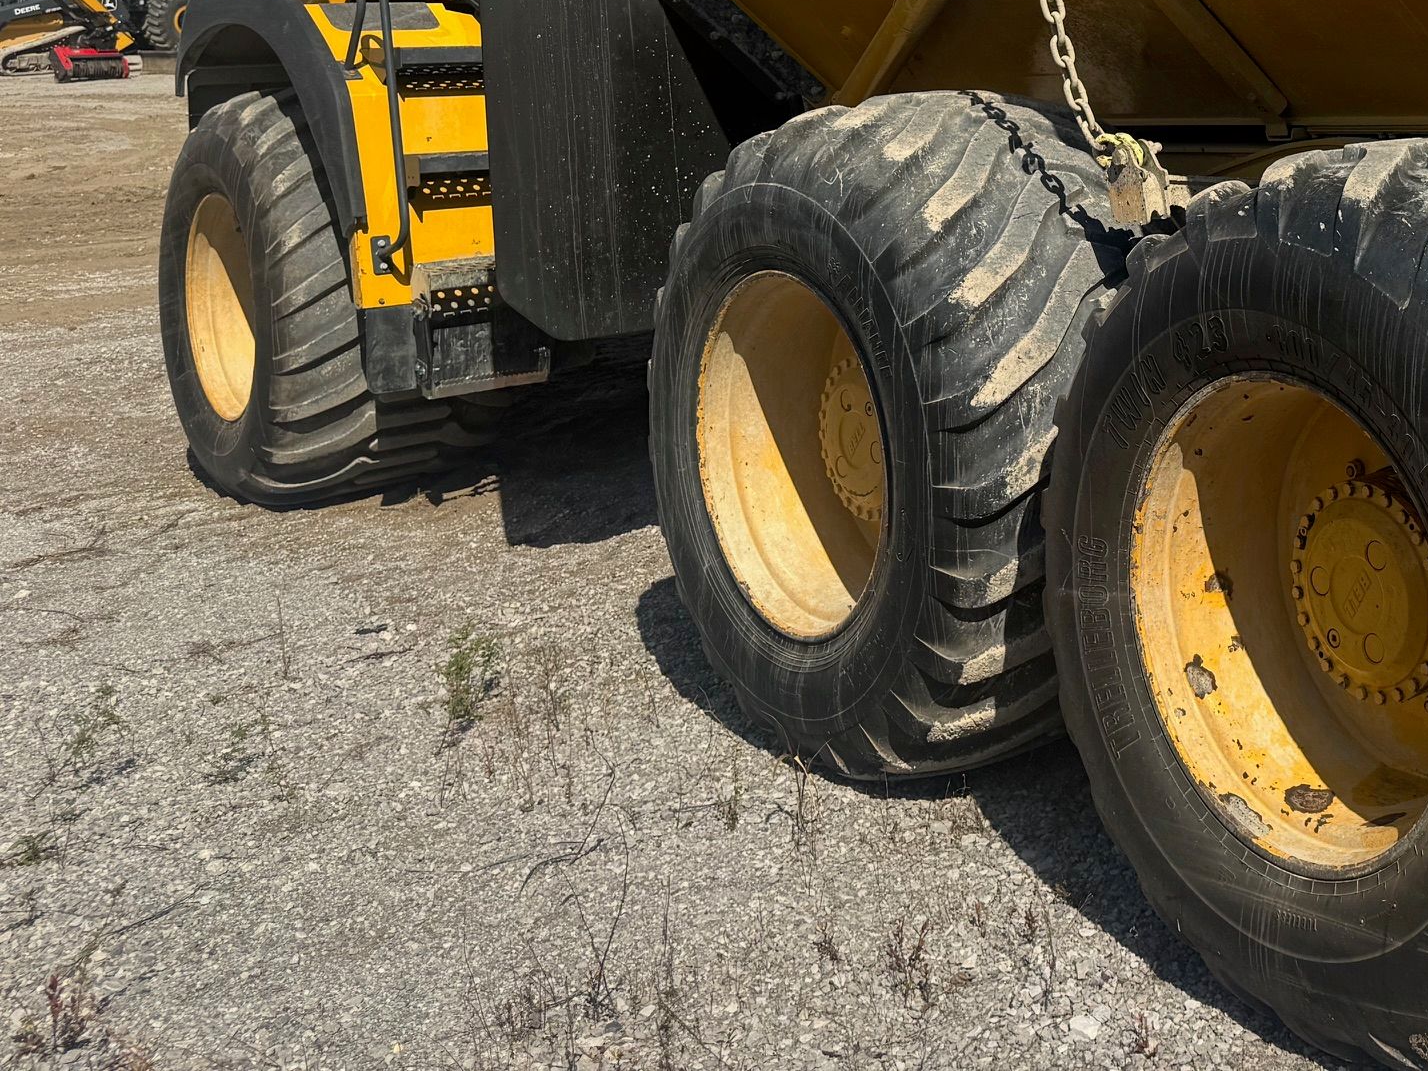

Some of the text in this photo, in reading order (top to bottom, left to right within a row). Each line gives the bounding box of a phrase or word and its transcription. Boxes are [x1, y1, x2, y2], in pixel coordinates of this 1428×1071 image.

[14, 4, 41, 16] DEERE
[1102, 353, 1168, 450] TWIN
[1076, 534, 1142, 761] TRELLEBORG
